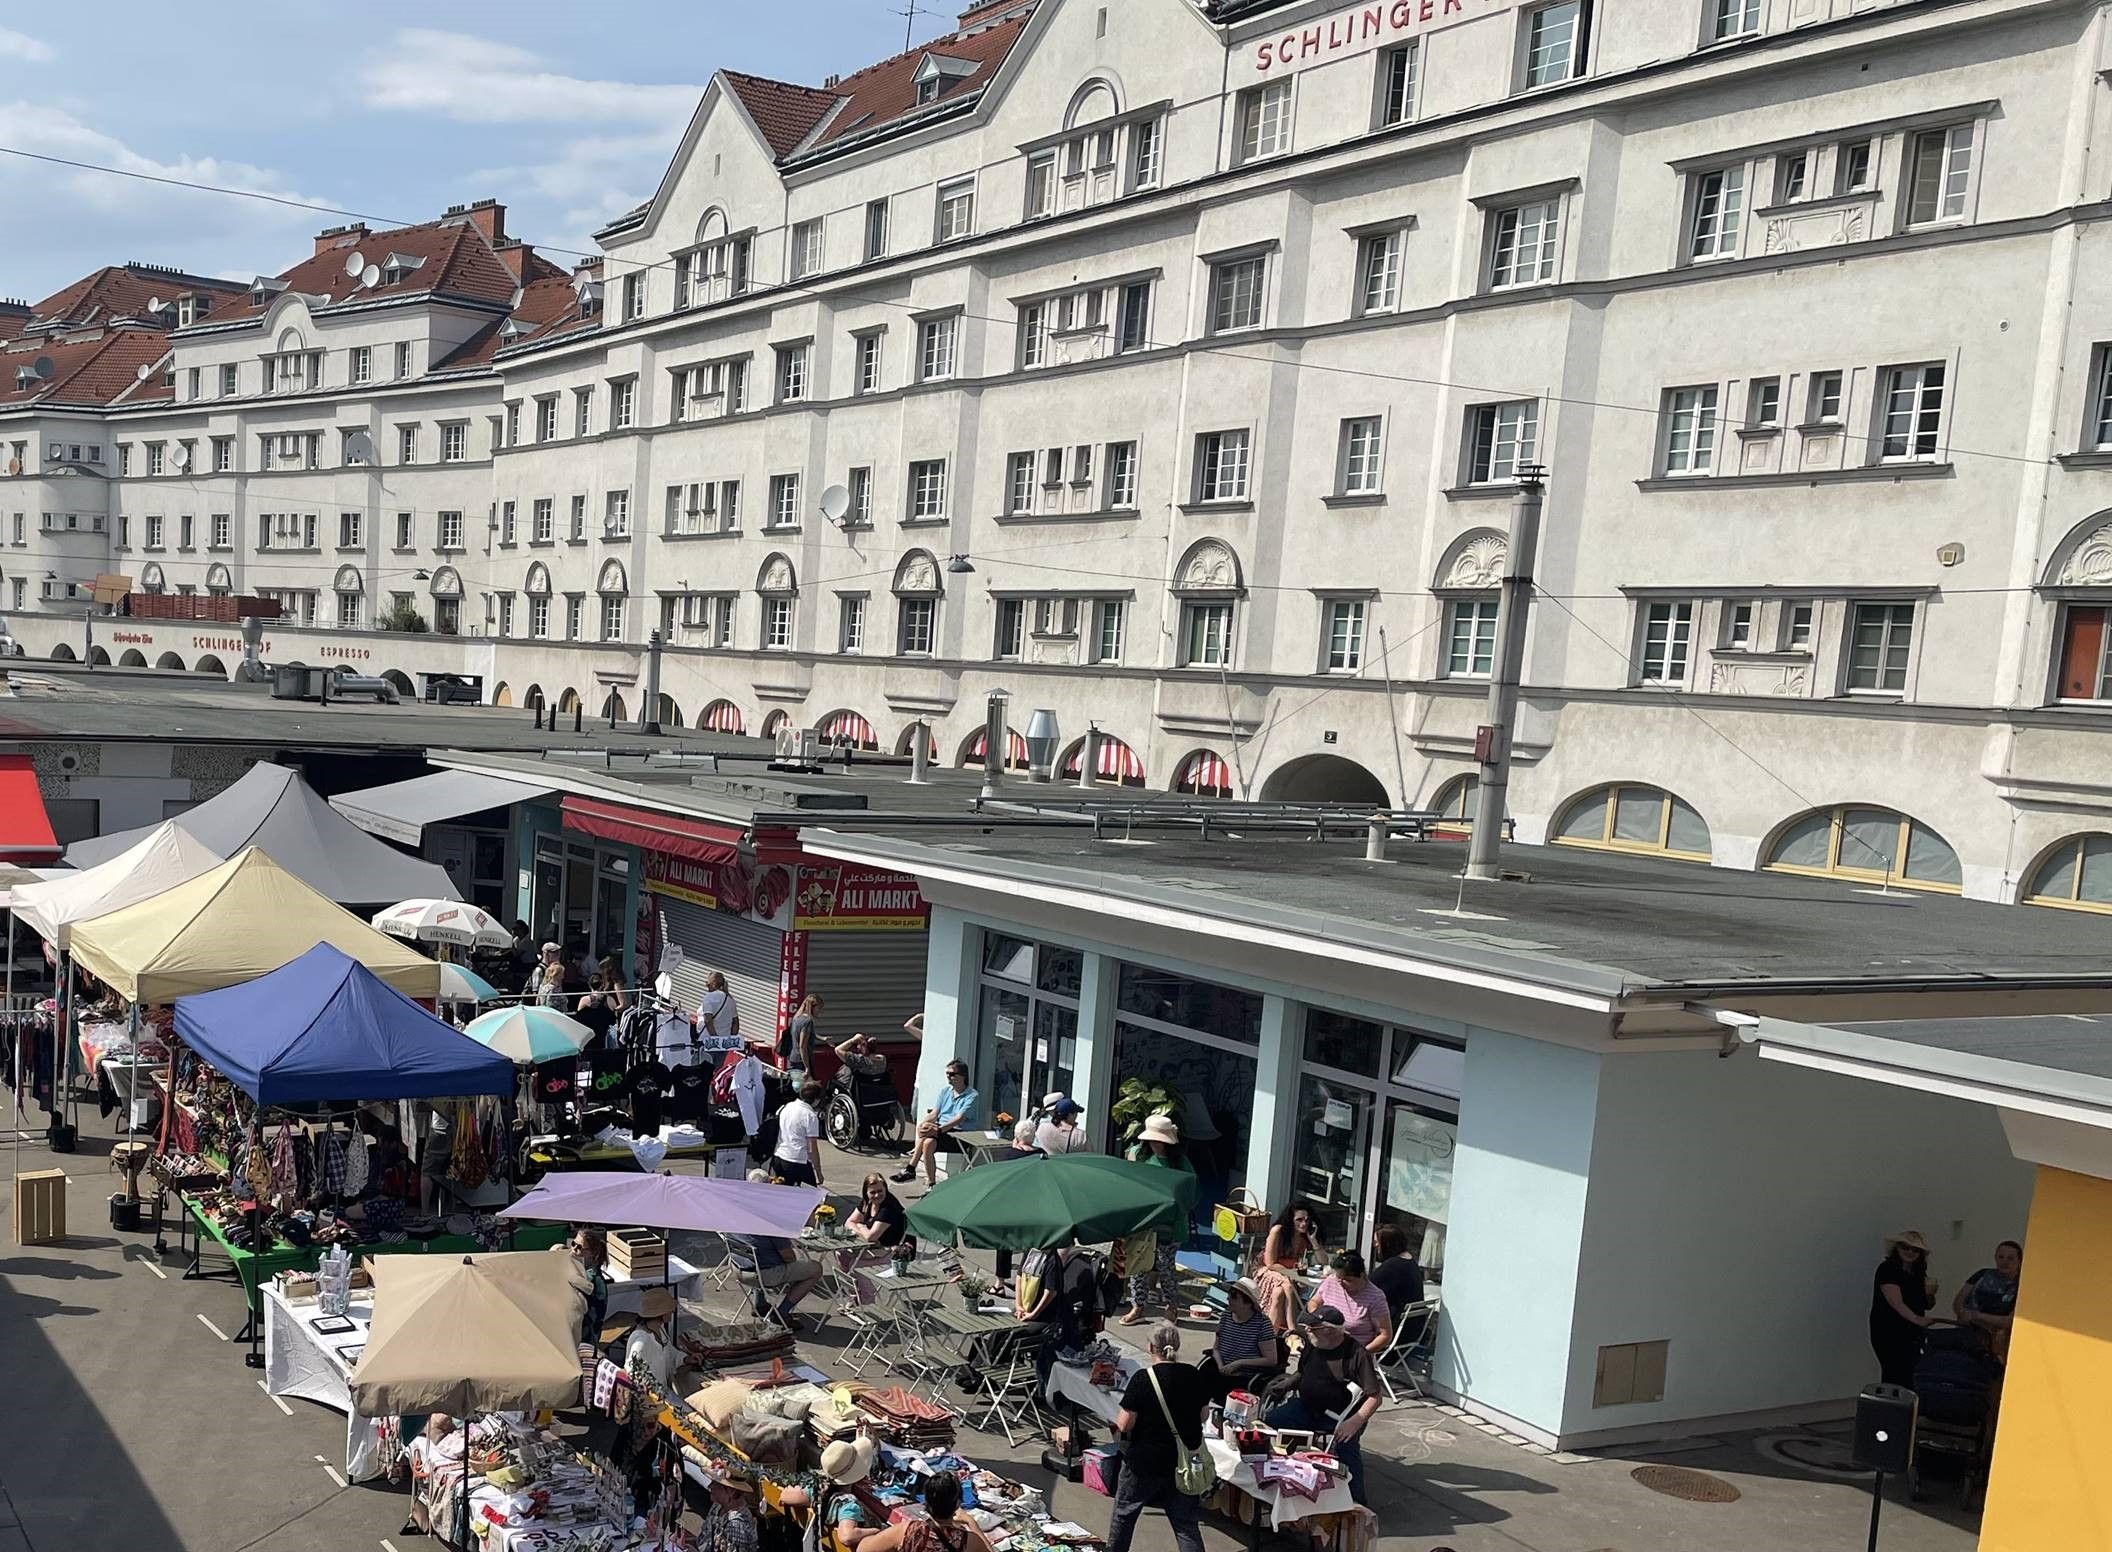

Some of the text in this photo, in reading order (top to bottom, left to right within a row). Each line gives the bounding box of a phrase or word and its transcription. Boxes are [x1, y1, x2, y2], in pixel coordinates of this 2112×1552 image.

[320, 647, 370, 660] ESPRESSO
[669, 860, 714, 889] ALI MARKT
[841, 889, 920, 909] ALI MARKT
[430, 930, 462, 941] HENKELL
